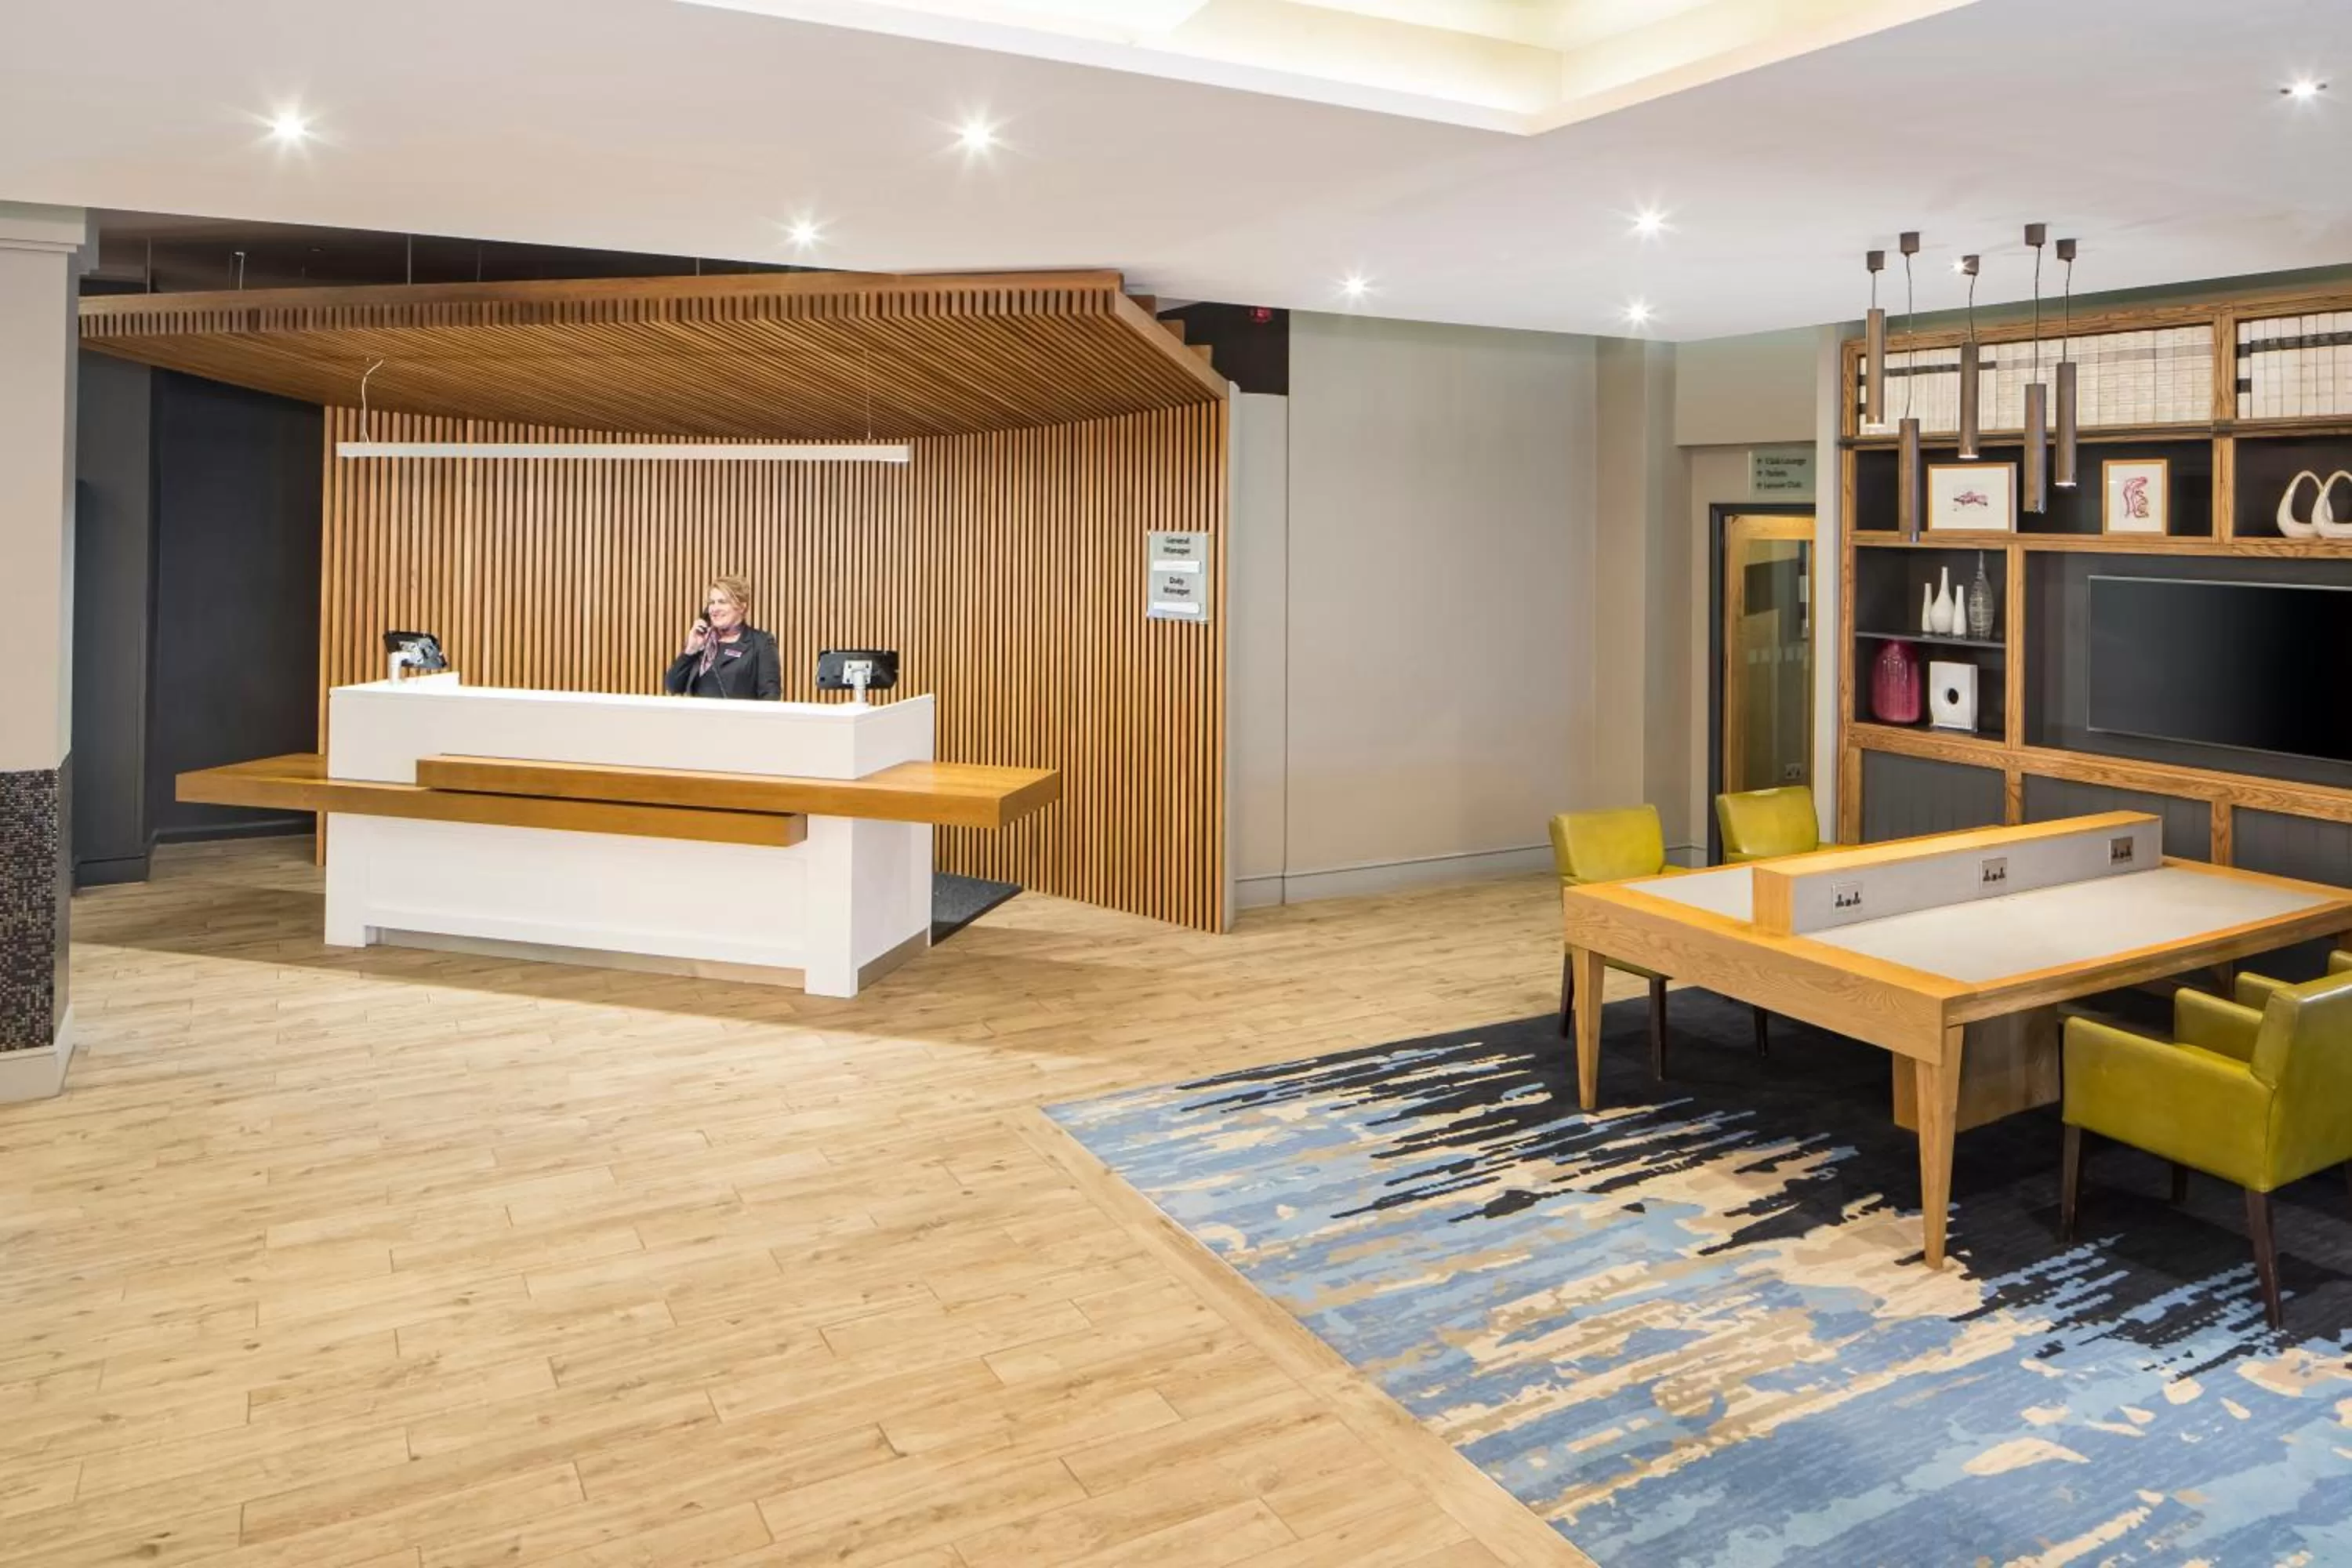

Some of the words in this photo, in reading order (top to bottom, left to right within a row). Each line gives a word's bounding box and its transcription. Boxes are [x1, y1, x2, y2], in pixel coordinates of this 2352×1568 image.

[1163, 546, 1190, 556] Manager
[1169, 577, 1185, 586] Duty
[1163, 586, 1190, 596] Manager
